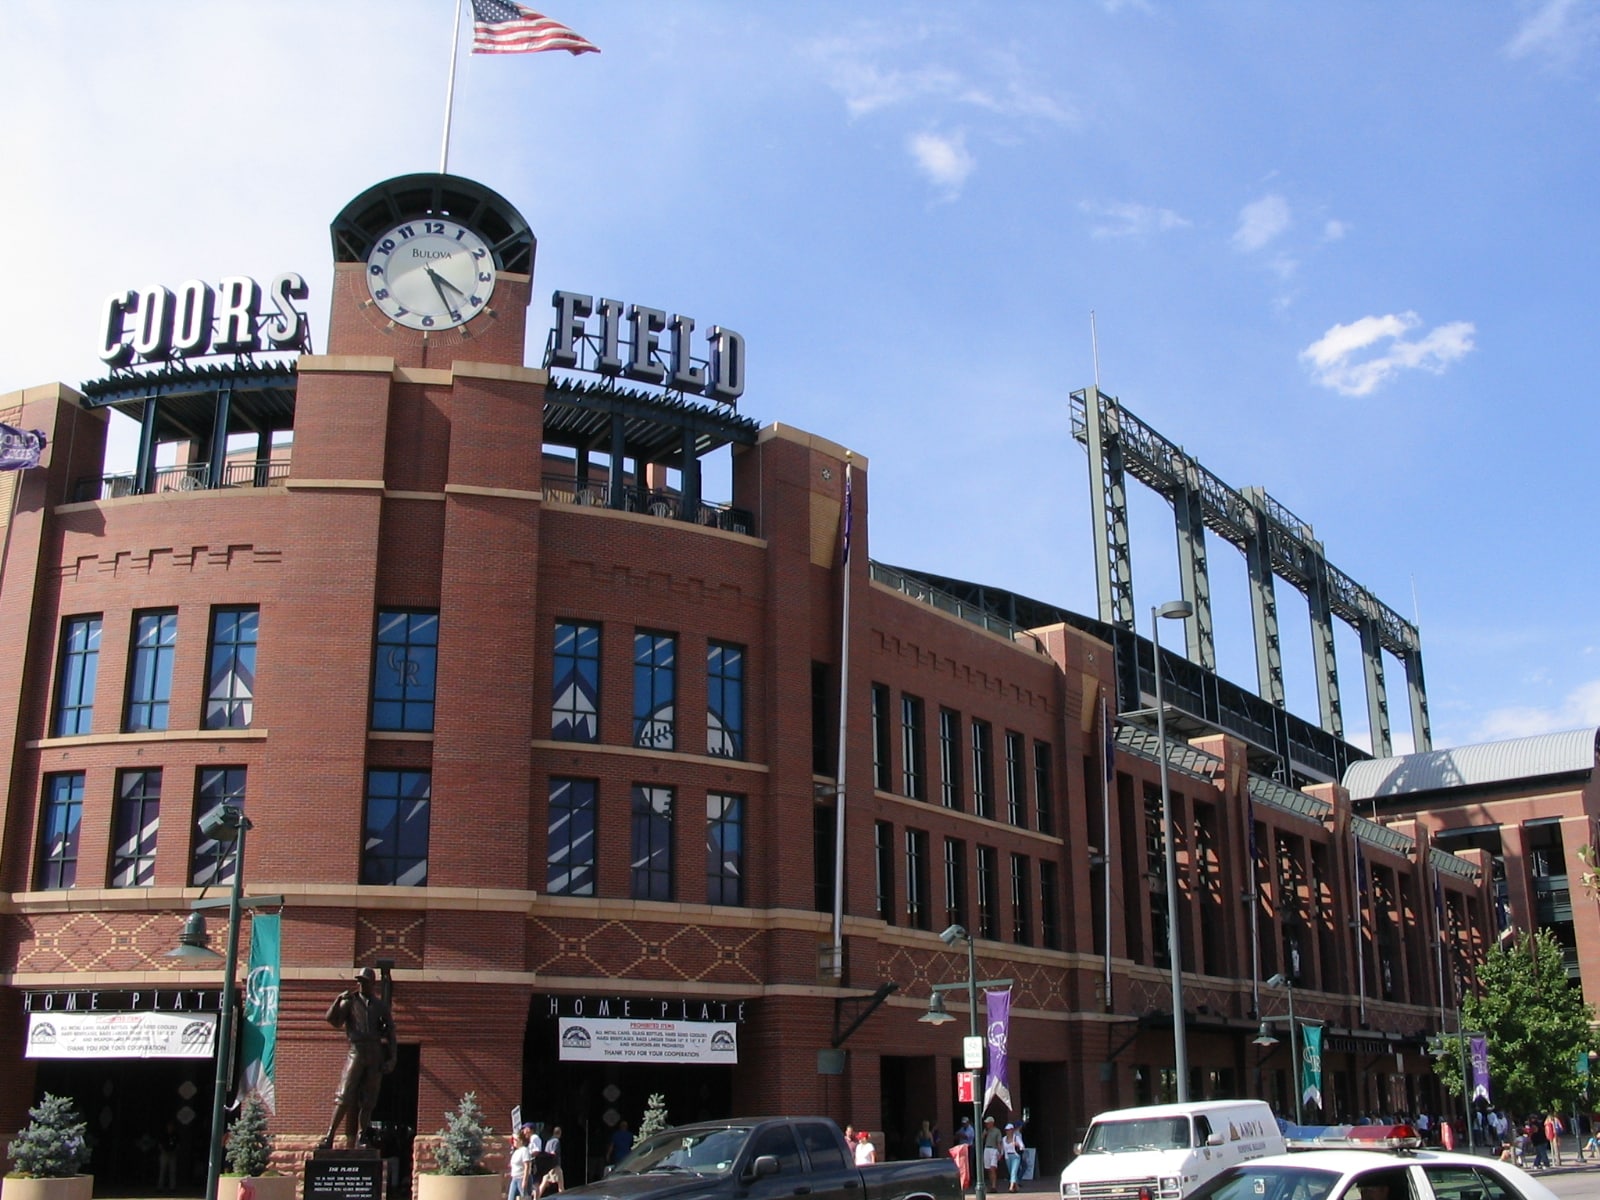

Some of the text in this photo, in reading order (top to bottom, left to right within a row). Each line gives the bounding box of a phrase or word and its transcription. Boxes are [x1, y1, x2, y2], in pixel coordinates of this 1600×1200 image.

[398, 226, 415, 239] 11
[424, 223, 445, 234] 12
[455, 228, 466, 240] 1
[377, 240, 396, 256] 10
[412, 248, 452, 260] BULOVA
[472, 248, 486, 260] 2
[370, 265, 383, 276] 9
[479, 272, 491, 282] 3
[375, 288, 389, 300] 8
[469, 295, 483, 308] 4
[393, 306, 409, 318] 7
[97, 271, 309, 368] COORS
[421, 315, 434, 327] 6
[549, 290, 746, 402] FIELD
[24, 992, 99, 1011] HOME
[550, 997, 745, 1020] HOME PLATE
